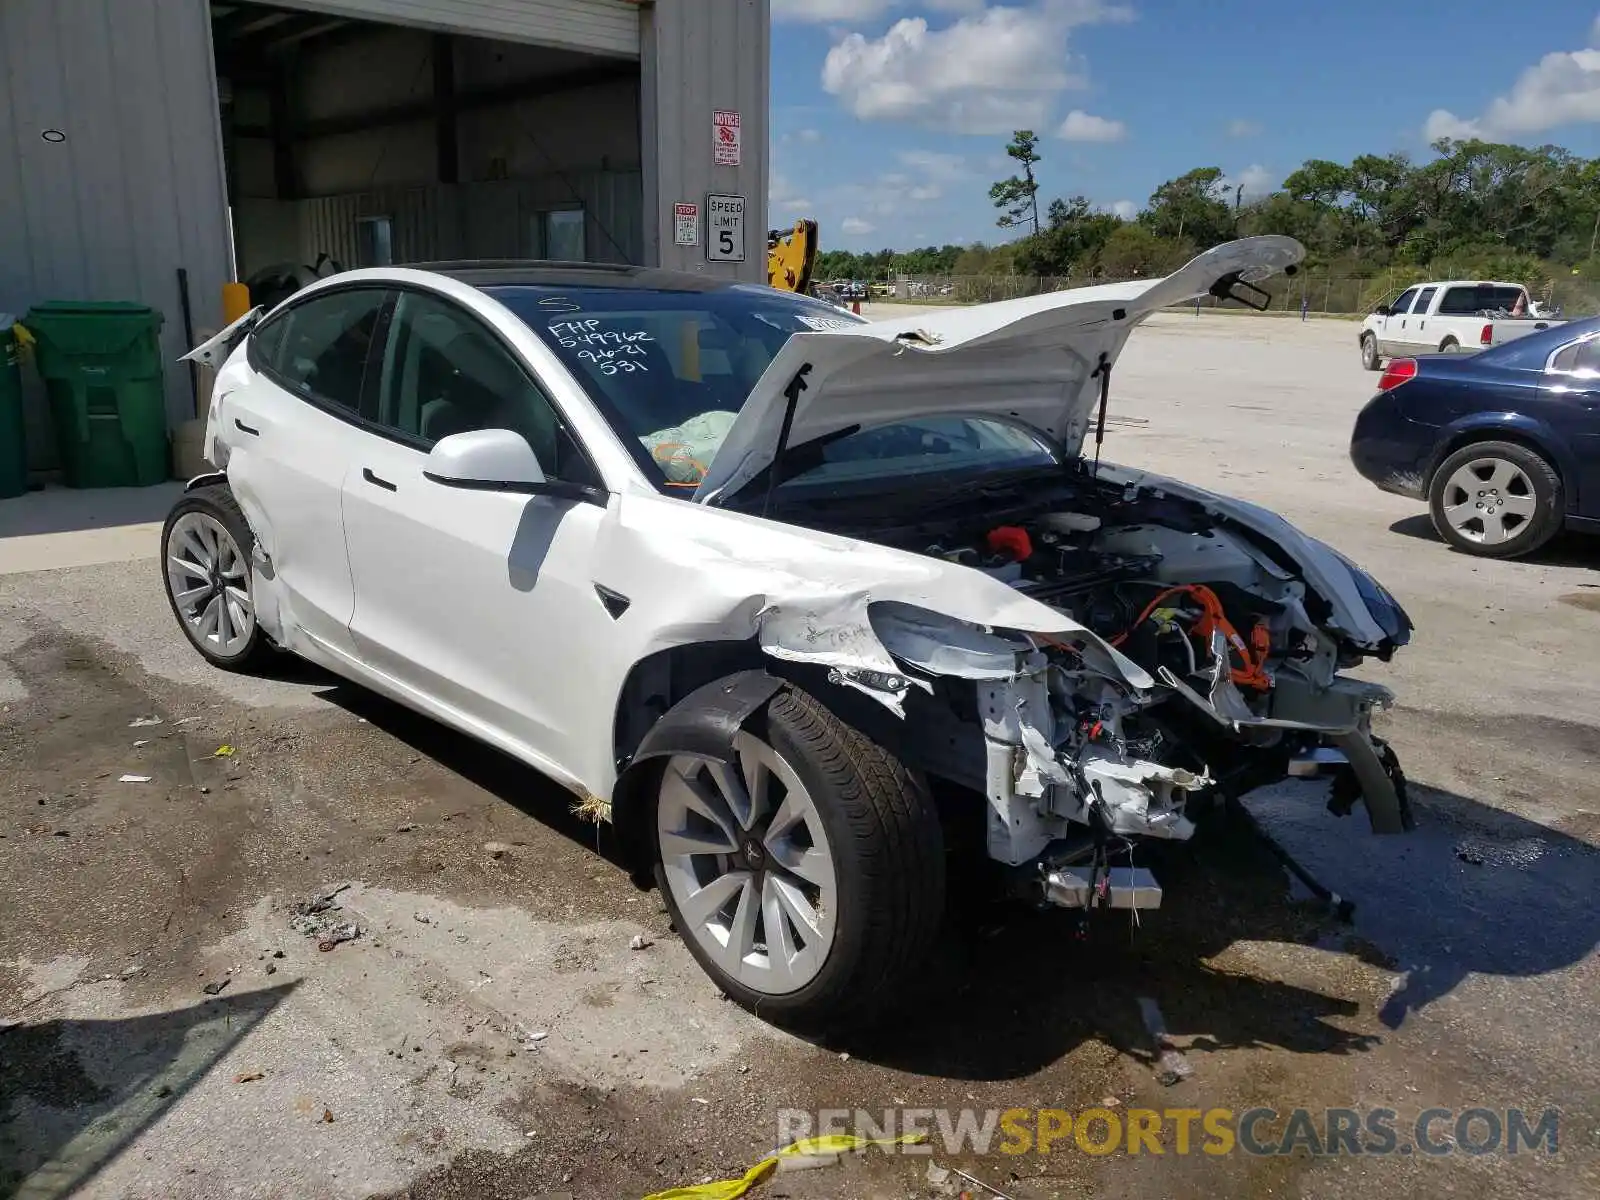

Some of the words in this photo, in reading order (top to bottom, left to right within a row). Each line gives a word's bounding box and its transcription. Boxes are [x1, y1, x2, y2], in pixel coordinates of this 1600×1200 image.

[714, 112, 740, 127] NOTICE
[677, 206, 696, 216] STOP
[711, 201, 743, 213] SPEED
[714, 216, 739, 227] LIMIT
[719, 230, 734, 255] 5
[548, 319, 600, 337] FHP
[558, 331, 656, 348] 549962
[600, 360, 649, 376] 531
